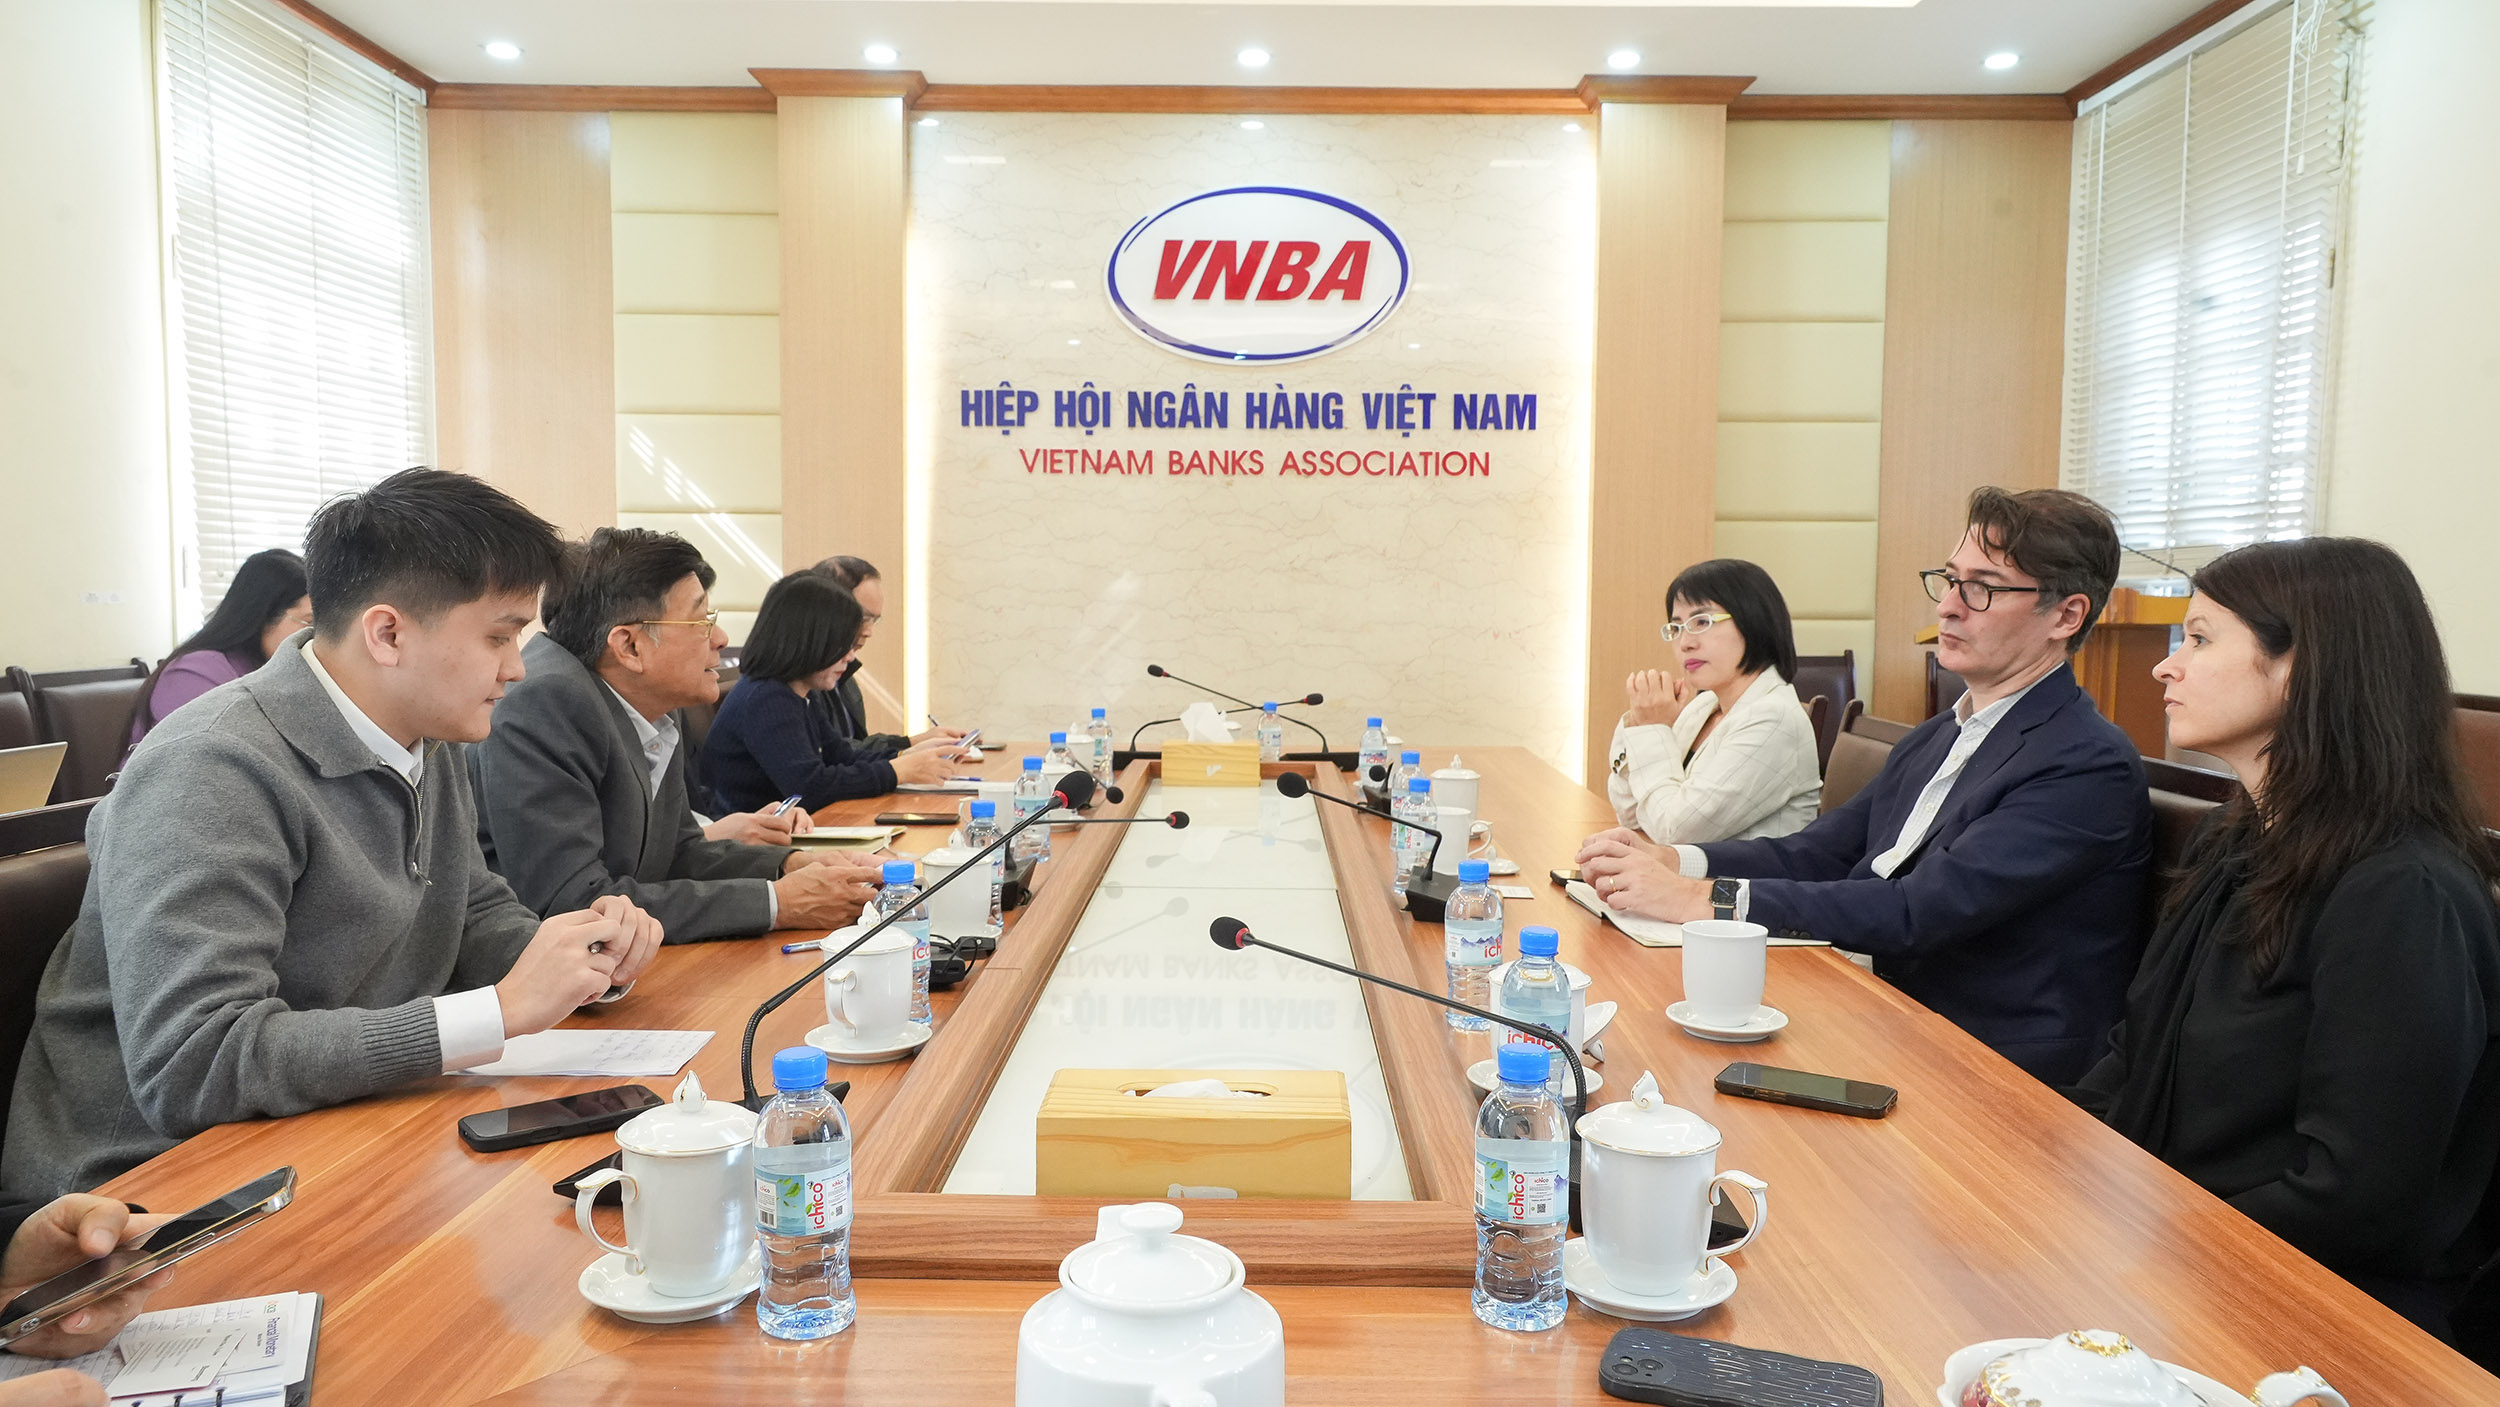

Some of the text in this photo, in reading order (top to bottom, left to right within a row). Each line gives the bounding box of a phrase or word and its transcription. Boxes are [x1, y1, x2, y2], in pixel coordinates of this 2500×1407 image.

[1154, 239, 1371, 302] VNBA
[961, 381, 1538, 438] HIỆP HỘI NGÂN HÀNG VIỆT NAM
[1019, 448, 1491, 477] VIETNAM BANKS ASSOCIATION
[807, 1182, 825, 1230] ichico
[1508, 1174, 1525, 1220] ichico
